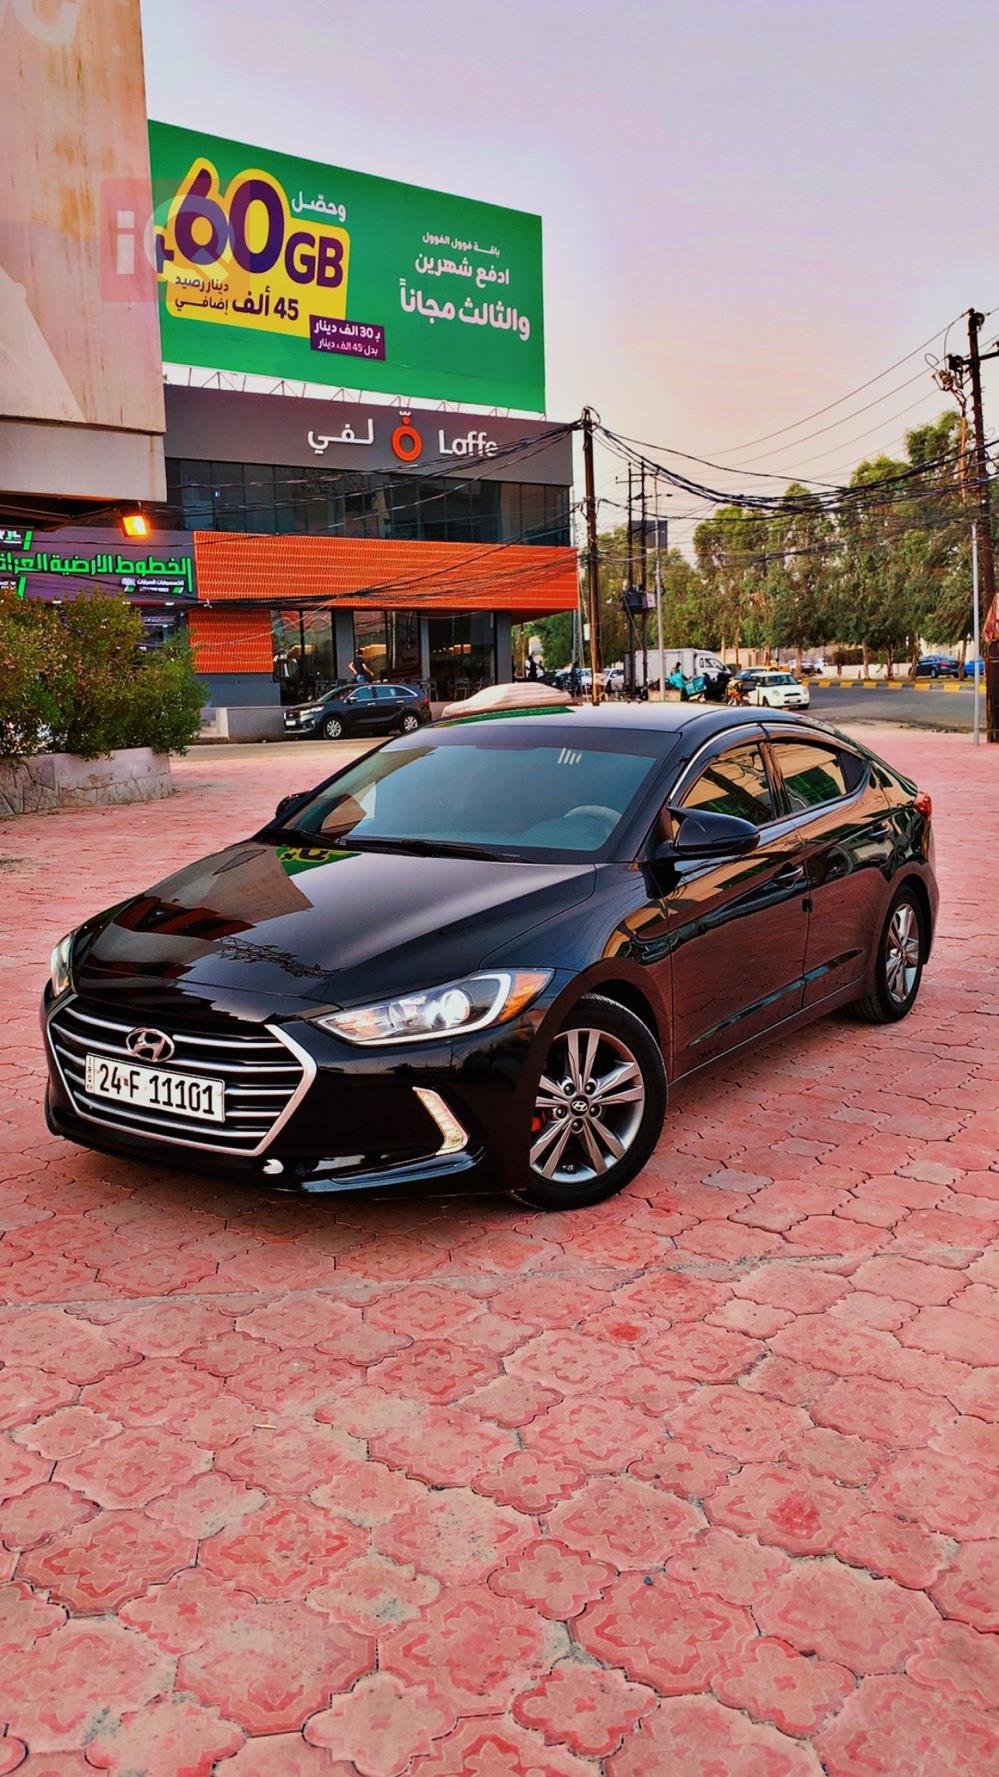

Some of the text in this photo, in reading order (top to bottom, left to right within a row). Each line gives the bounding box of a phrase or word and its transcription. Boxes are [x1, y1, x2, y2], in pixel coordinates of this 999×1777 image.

[415, 253, 510, 288] ادفع شهرين
[174, 297, 229, 316] إضافي
[232, 286, 299, 321] 45 ألف
[458, 296, 531, 341] والثالث
[313, 319, 338, 336] دينار
[318, 338, 336, 351] دينار
[359, 326, 374, 339] 30
[115, 554, 193, 593] الخطوط
[99, 1063, 122, 1095] 24
[129, 1070, 141, 1098] F
[149, 1075, 215, 1115] 11101
